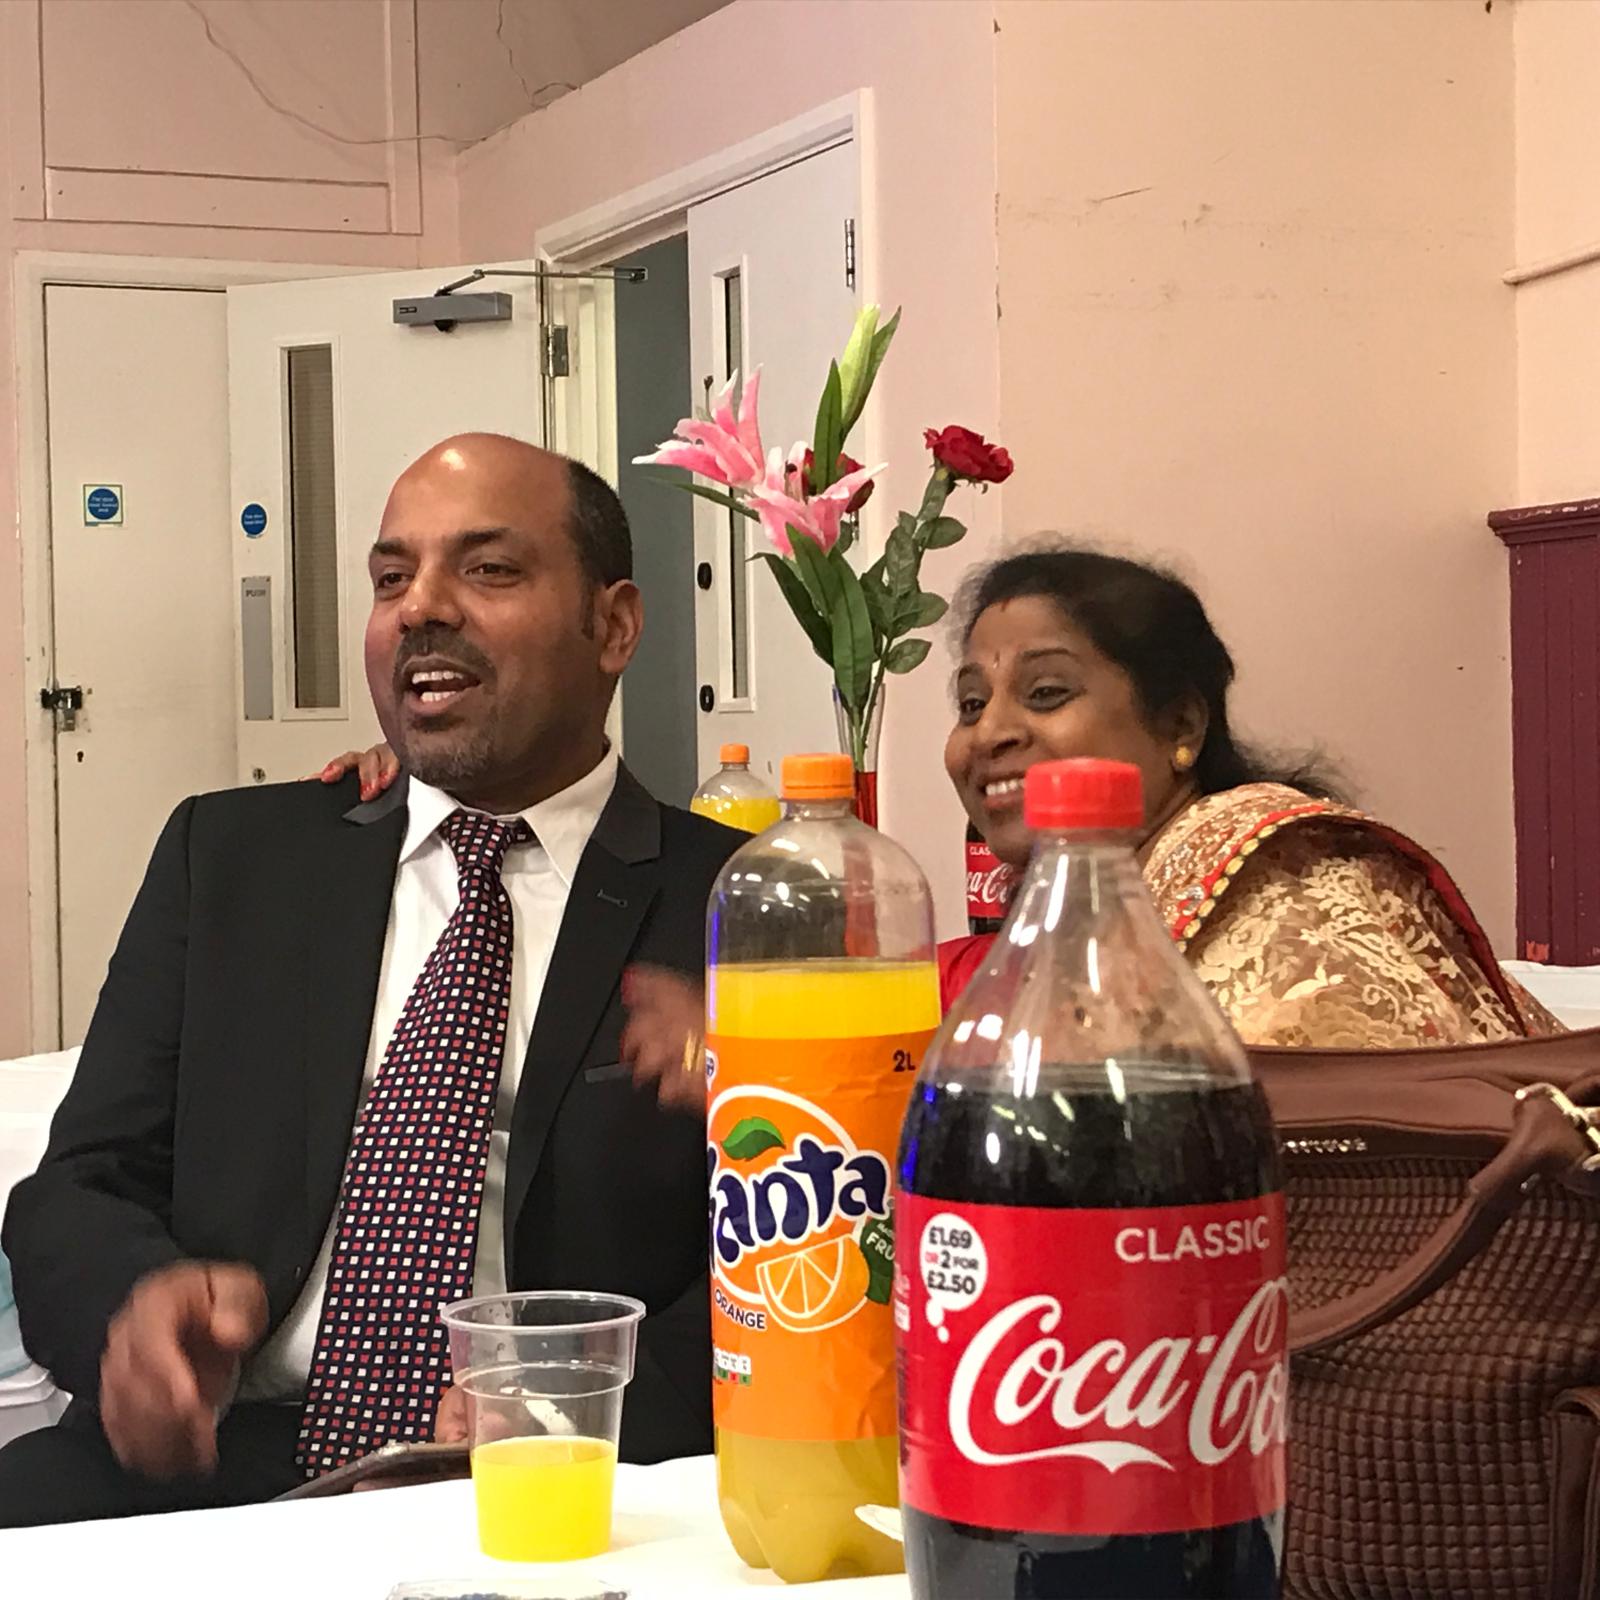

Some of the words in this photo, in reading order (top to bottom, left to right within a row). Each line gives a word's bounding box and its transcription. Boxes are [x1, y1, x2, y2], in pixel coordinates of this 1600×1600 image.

[893, 1050, 917, 1072] 2L
[929, 1226, 972, 1249] £1.69
[1114, 1215, 1270, 1263] CLASSIC
[941, 1250, 951, 1269] 2
[927, 1270, 976, 1295] £2.50
[715, 1289, 766, 1330] ORANGE
